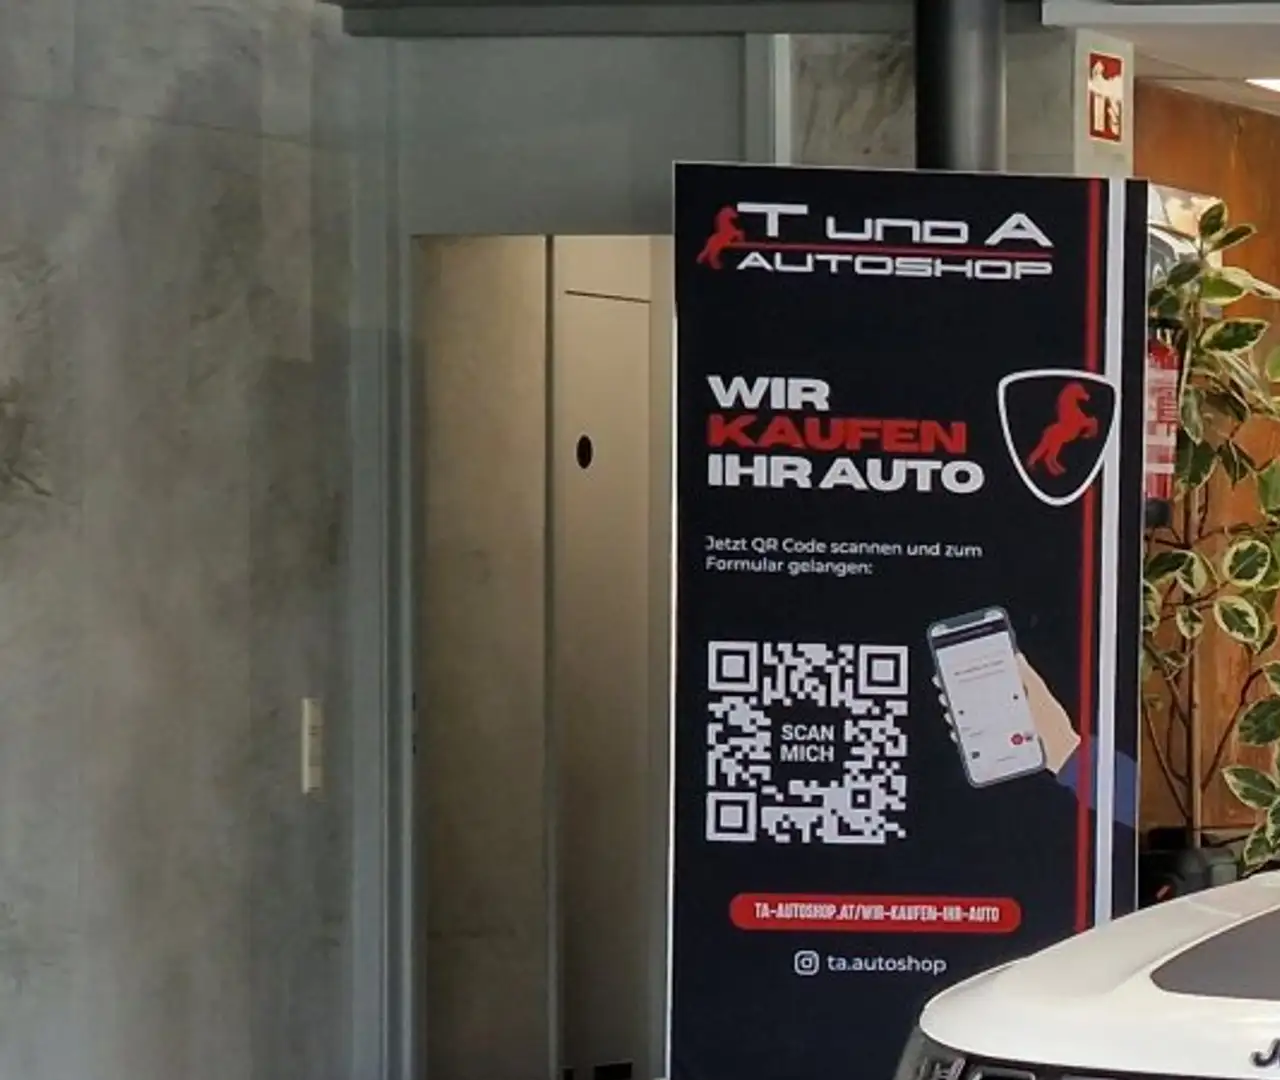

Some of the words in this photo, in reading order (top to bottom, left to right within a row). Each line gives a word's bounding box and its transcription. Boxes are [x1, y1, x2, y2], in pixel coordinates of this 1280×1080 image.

[737, 202, 808, 237] T
[985, 212, 1053, 248] A
[737, 251, 1053, 281] AUTOSHOP
[707, 375, 830, 411] WIR
[707, 413, 967, 454] KAUFEN
[708, 454, 813, 489] IHR
[818, 457, 985, 494] AUTO
[705, 535, 748, 552] Jetzt
[751, 537, 778, 553] QR
[782, 537, 826, 554] Code
[830, 538, 902, 556] scannen
[906, 540, 940, 557] und
[945, 544, 983, 558] zum
[706, 555, 784, 574] Formular
[788, 557, 873, 578] gelangen:
[781, 724, 834, 741] SCAN
[780, 744, 834, 762] MICH
[827, 954, 947, 976] ta.autoshop
